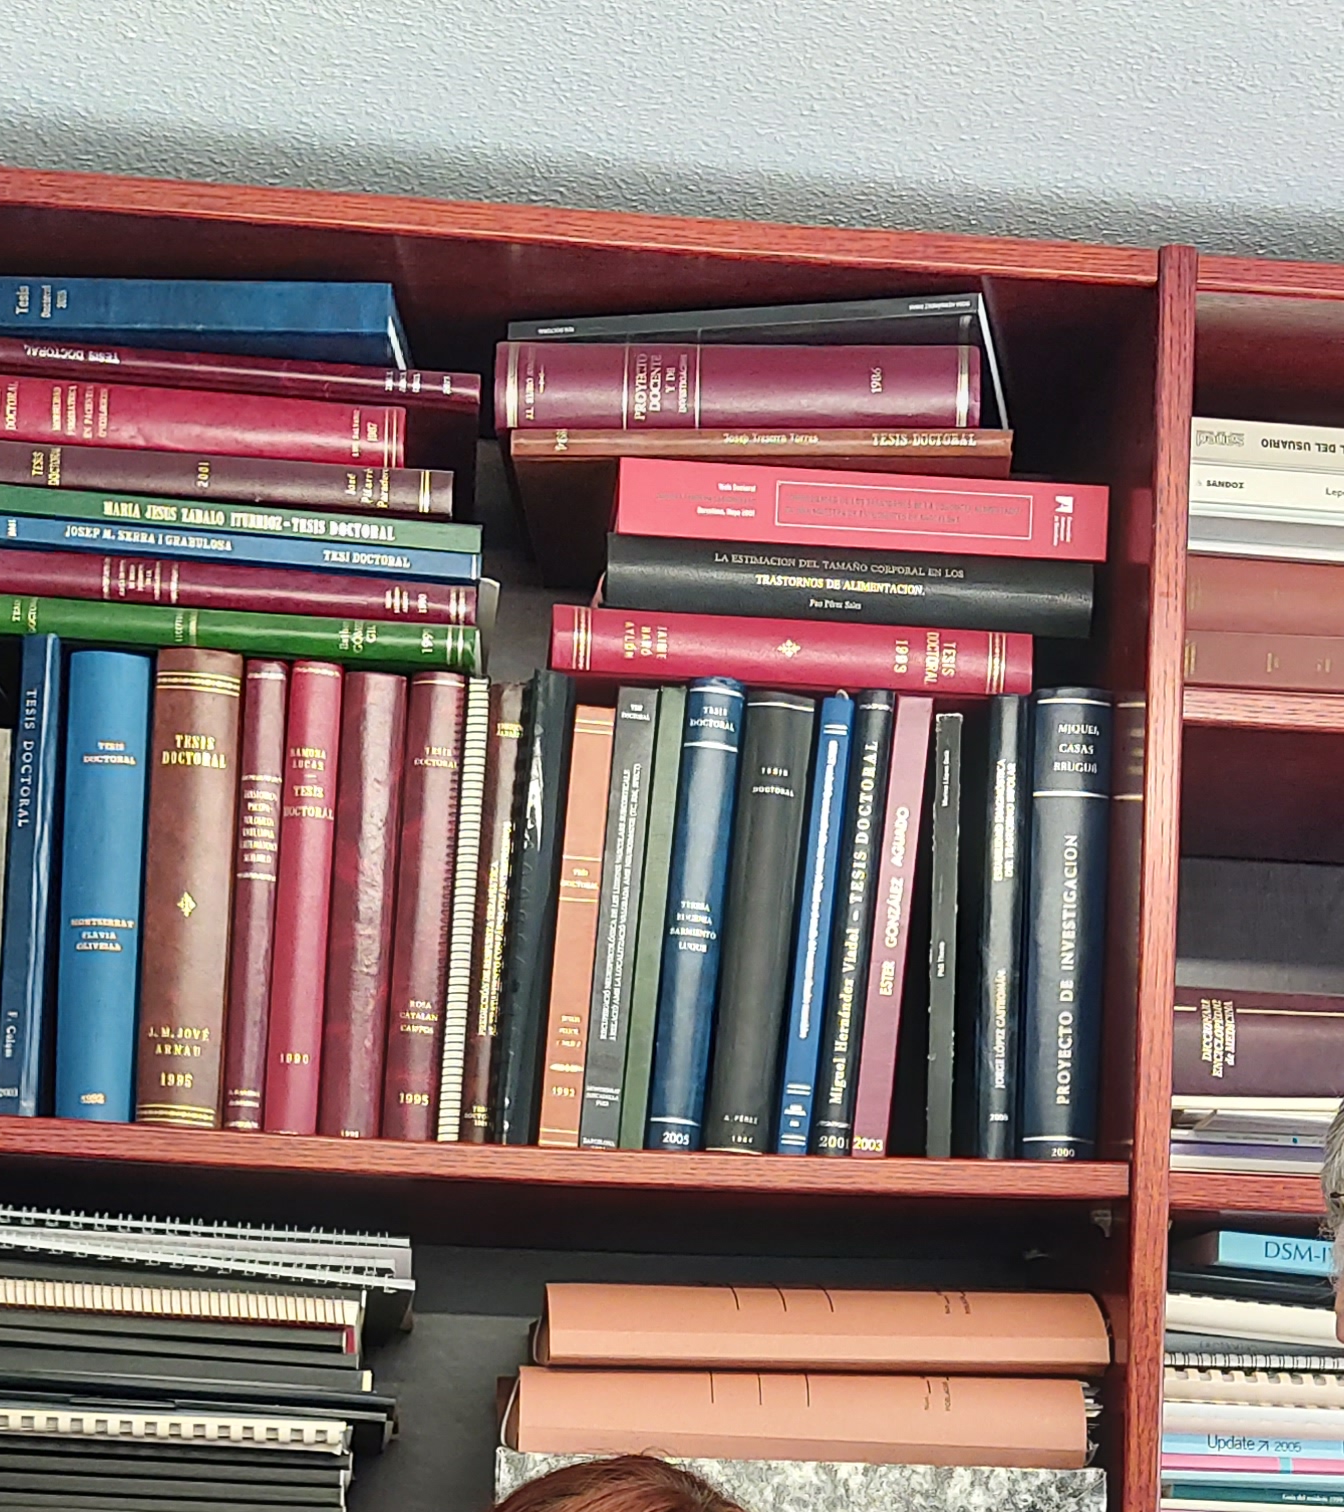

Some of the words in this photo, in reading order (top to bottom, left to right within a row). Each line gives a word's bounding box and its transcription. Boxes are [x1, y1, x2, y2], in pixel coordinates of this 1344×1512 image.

[634, 353, 647, 421] PROYECTO
[649, 355, 662, 413] DOCENTE
[5, 381, 19, 431] DOCTORAL
[871, 432, 910, 447] TESIS
[913, 432, 978, 448] DOCTORAL
[1260, 436, 1313, 452] USUARIO
[1314, 441, 1338, 455] DEL
[31, 451, 44, 477] TESIS
[196, 461, 210, 488] 2001
[1205, 479, 1246, 490] SANDOZ
[103, 501, 141, 519] MARIA
[145, 504, 177, 521] JESUS
[329, 520, 396, 542] DOCTORAL
[65, 525, 100, 539] JOSEP
[103, 529, 116, 541] M.
[118, 531, 155, 545] SERRA
[165, 535, 233, 552] GRABULOSA
[323, 550, 350, 563] TESI
[352, 553, 411, 568] DOCTORAL
[715, 552, 729, 563] LA
[731, 554, 797, 567] ESTIMACION
[798, 559, 820, 569] DEL
[823, 560, 868, 574] TAMAÑO
[870, 564, 926, 577] CORPORAL
[928, 567, 942, 578] EN
[945, 569, 965, 579] LOS
[756, 574, 824, 589] TRASTORNOS
[825, 578, 841, 590] DE
[843, 580, 926, 596] ALIMENTACION.
[924, 631, 940, 686] DOCTORAL
[941, 641, 957, 678] TESIS
[24, 688, 38, 729] TESIS
[689, 717, 735, 732] DOCTORAL
[175, 734, 216, 750] TESIS
[1058, 743, 1095, 755] CASAS
[161, 750, 227, 769] DOCTORAL
[16, 740, 35, 827] DOCTORAL
[293, 785, 325, 799] TESIS
[752, 785, 795, 798] DOCTORAL
[856, 741, 878, 845] DOCTORAL
[284, 805, 335, 821] DOCTORAL
[891, 807, 910, 867] AGUADO
[849, 848, 868, 905] TESIS
[680, 900, 711, 912] TERESA
[885, 876, 904, 949] GONZÁLEZ
[1060, 834, 1079, 972] INVESTIGACION
[669, 927, 718, 940] SARMIENTO
[880, 960, 896, 996] ESTER
[1059, 978, 1074, 1003] DE
[410, 1000, 432, 1010] ROSA
[400, 1011, 439, 1022] CATALAN
[834, 978, 856, 1054] Hernández
[148, 1027, 166, 1039] J.
[169, 1027, 185, 1039] M.
[186, 1026, 211, 1042] JOVÉ
[155, 1043, 202, 1058] ARNAU
[1056, 1010, 1074, 1106] PROYECTO
[829, 1058, 847, 1105] Miguel
[399, 1092, 429, 1106] 1995
[662, 1132, 690, 1146] 2005
[818, 1135, 851, 1149] 2001
[853, 1137, 884, 1152] 2003
[1051, 1147, 1076, 1158] 2000
[1207, 1434, 1256, 1452] Update
